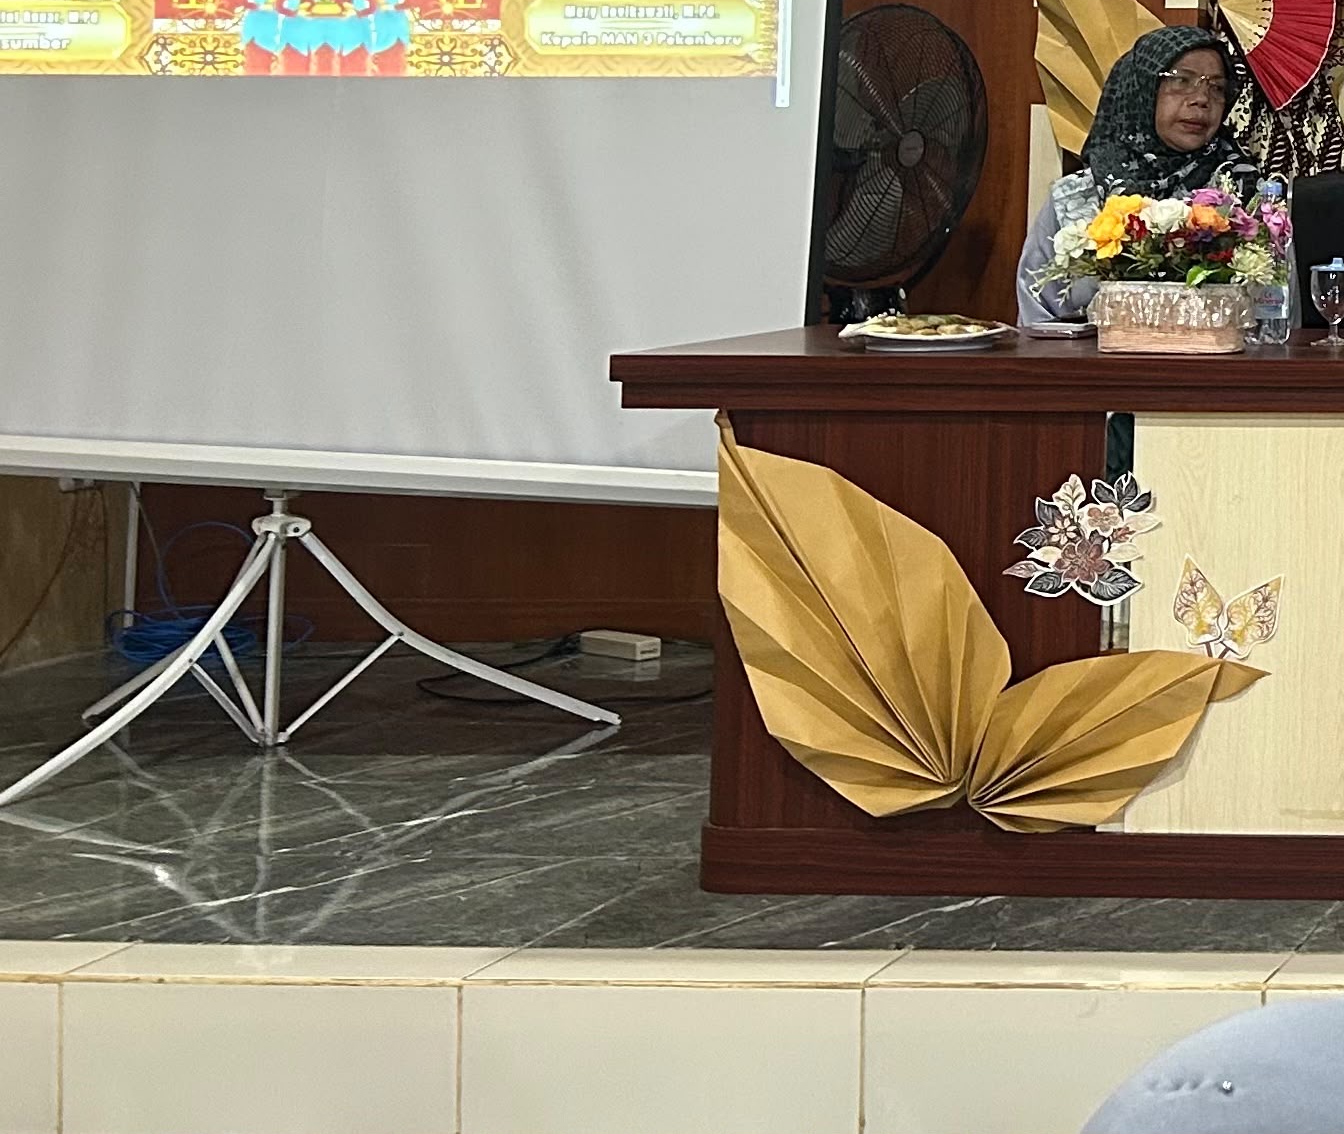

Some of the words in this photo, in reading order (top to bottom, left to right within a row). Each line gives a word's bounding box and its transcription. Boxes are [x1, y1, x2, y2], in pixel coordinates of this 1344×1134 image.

[601, 32, 639, 46] MAN
[643, 32, 653, 46] 3
[656, 31, 743, 46] Pekanbaru
